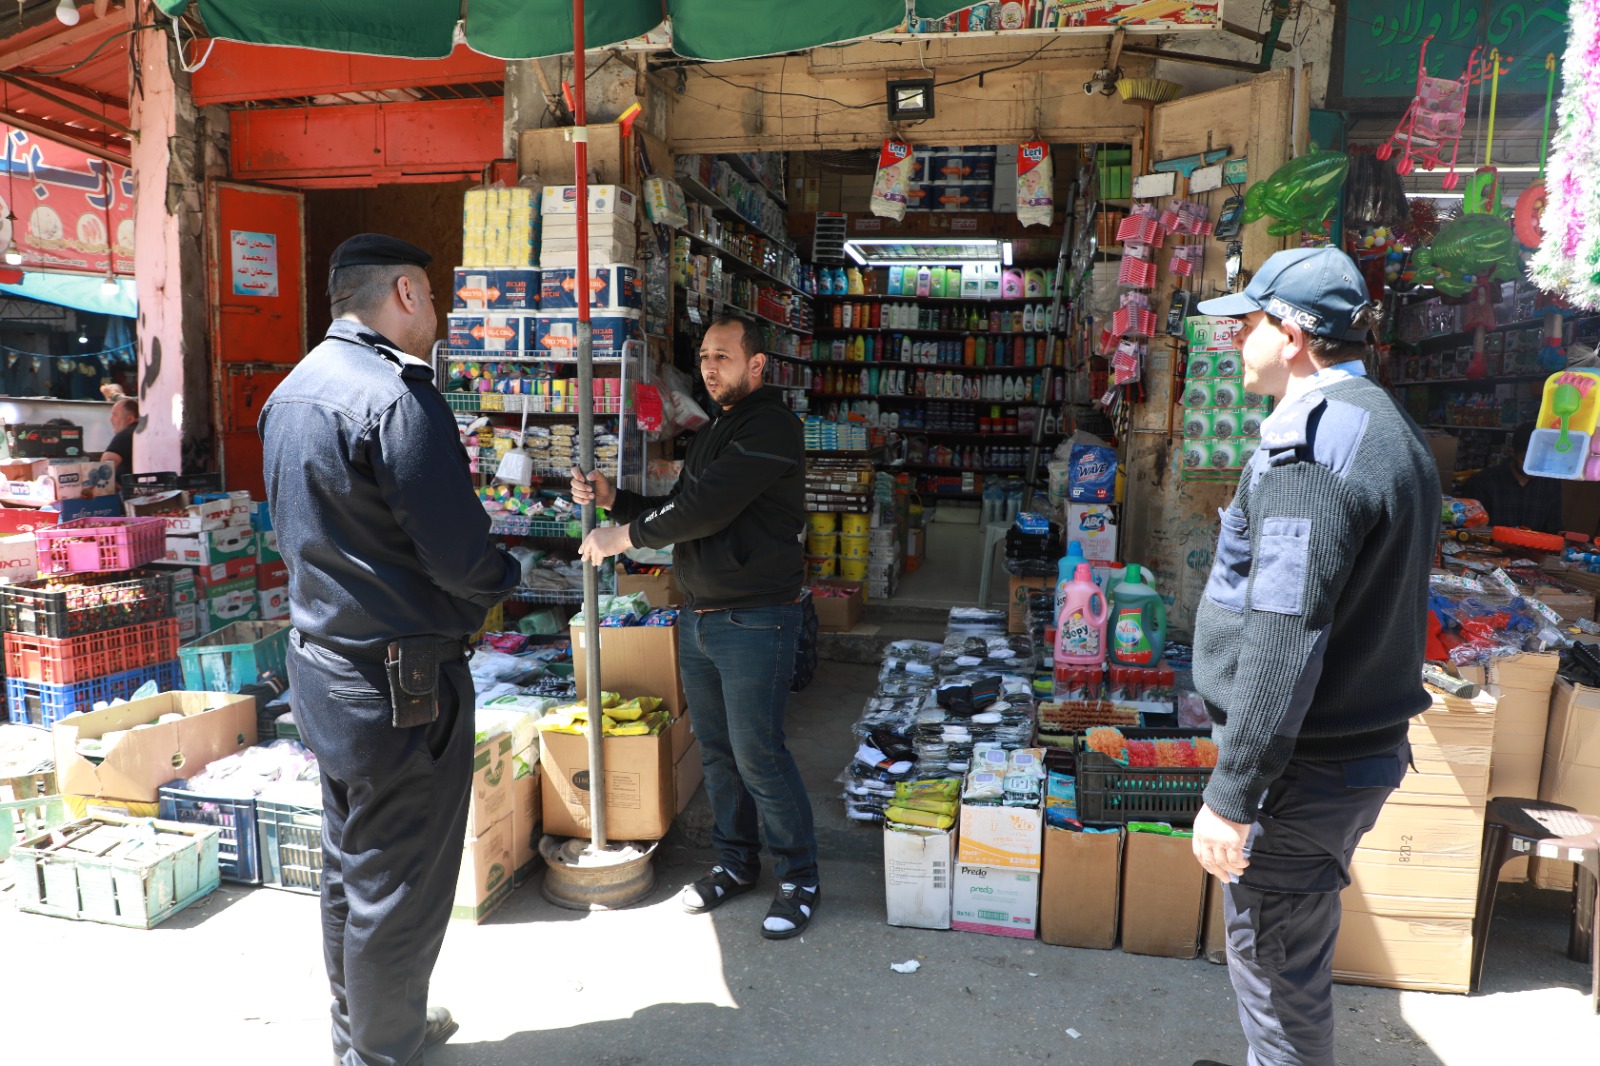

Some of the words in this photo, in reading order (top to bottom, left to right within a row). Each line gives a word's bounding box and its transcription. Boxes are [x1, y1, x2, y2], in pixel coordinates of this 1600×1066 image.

[236, 238, 248, 246] الله
[250, 240, 272, 249] سبحان
[242, 255, 268, 264] وبحمده
[237, 265, 249, 274] الله
[250, 268, 273, 277] سبحان
[1268, 299, 1317, 328] POLICE
[1077, 463, 1107, 477] WAVE
[1084, 517, 1103, 527] ABC
[1399, 835, 1413, 862] 820-2
[961, 867, 987, 877] Predo
[970, 886, 994, 894] predo
